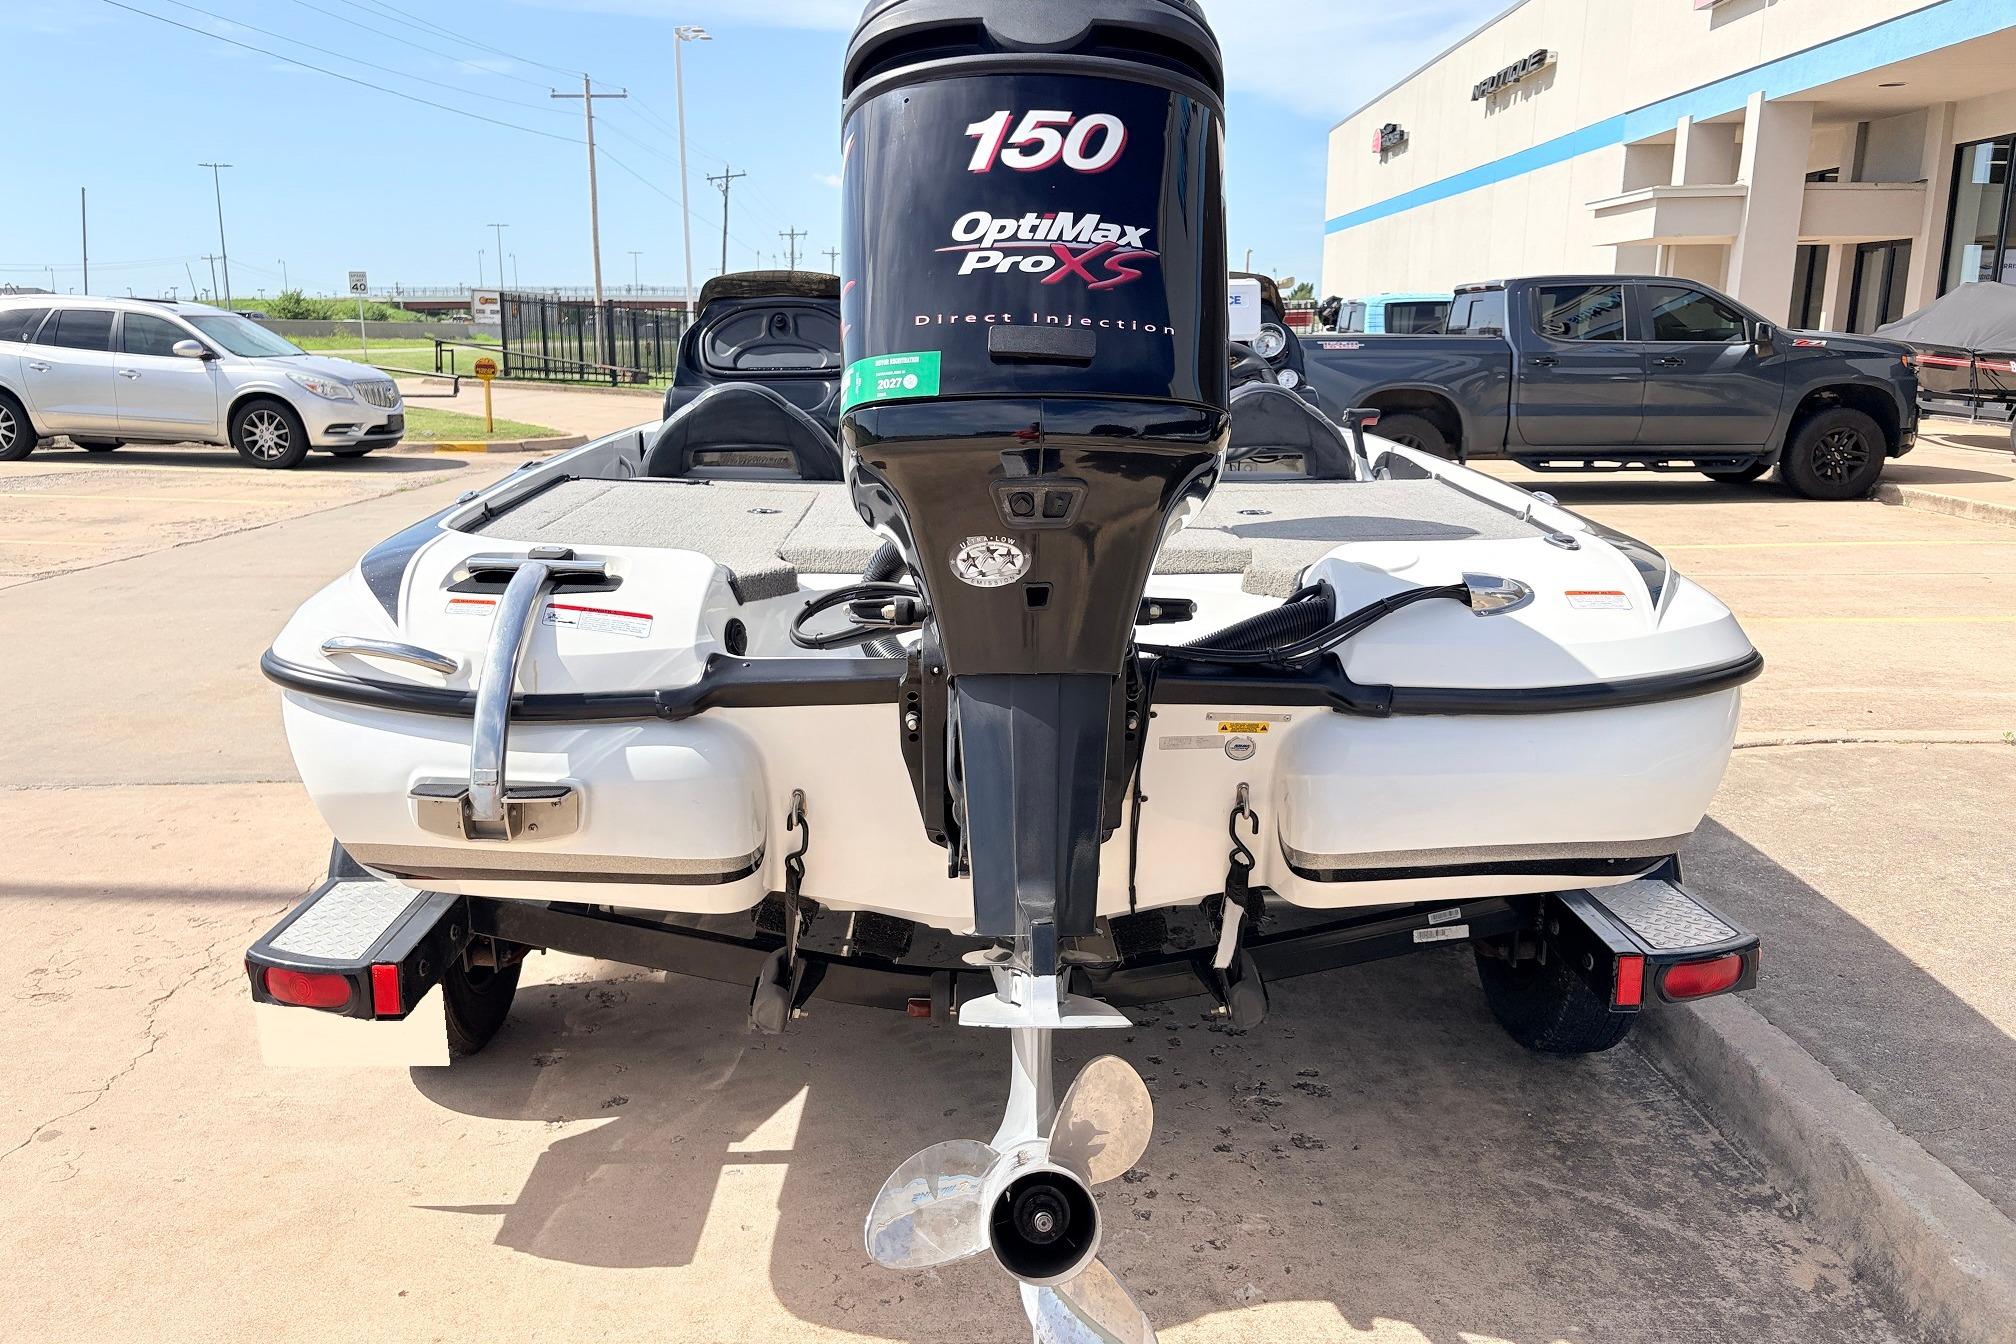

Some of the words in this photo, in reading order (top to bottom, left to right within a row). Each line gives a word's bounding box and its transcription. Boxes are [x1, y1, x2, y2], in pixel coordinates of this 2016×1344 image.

[1471, 49, 1548, 101] NAUTIQUE
[964, 110, 1128, 174] 150
[951, 211, 1151, 249] OptiMax
[351, 283, 366, 291] 40
[914, 312, 1011, 326] Direct
[1032, 312, 1176, 336] Injection
[877, 377, 903, 390] 2027
[995, 535, 1016, 545] LOW
[970, 575, 1016, 586] EMISSION
